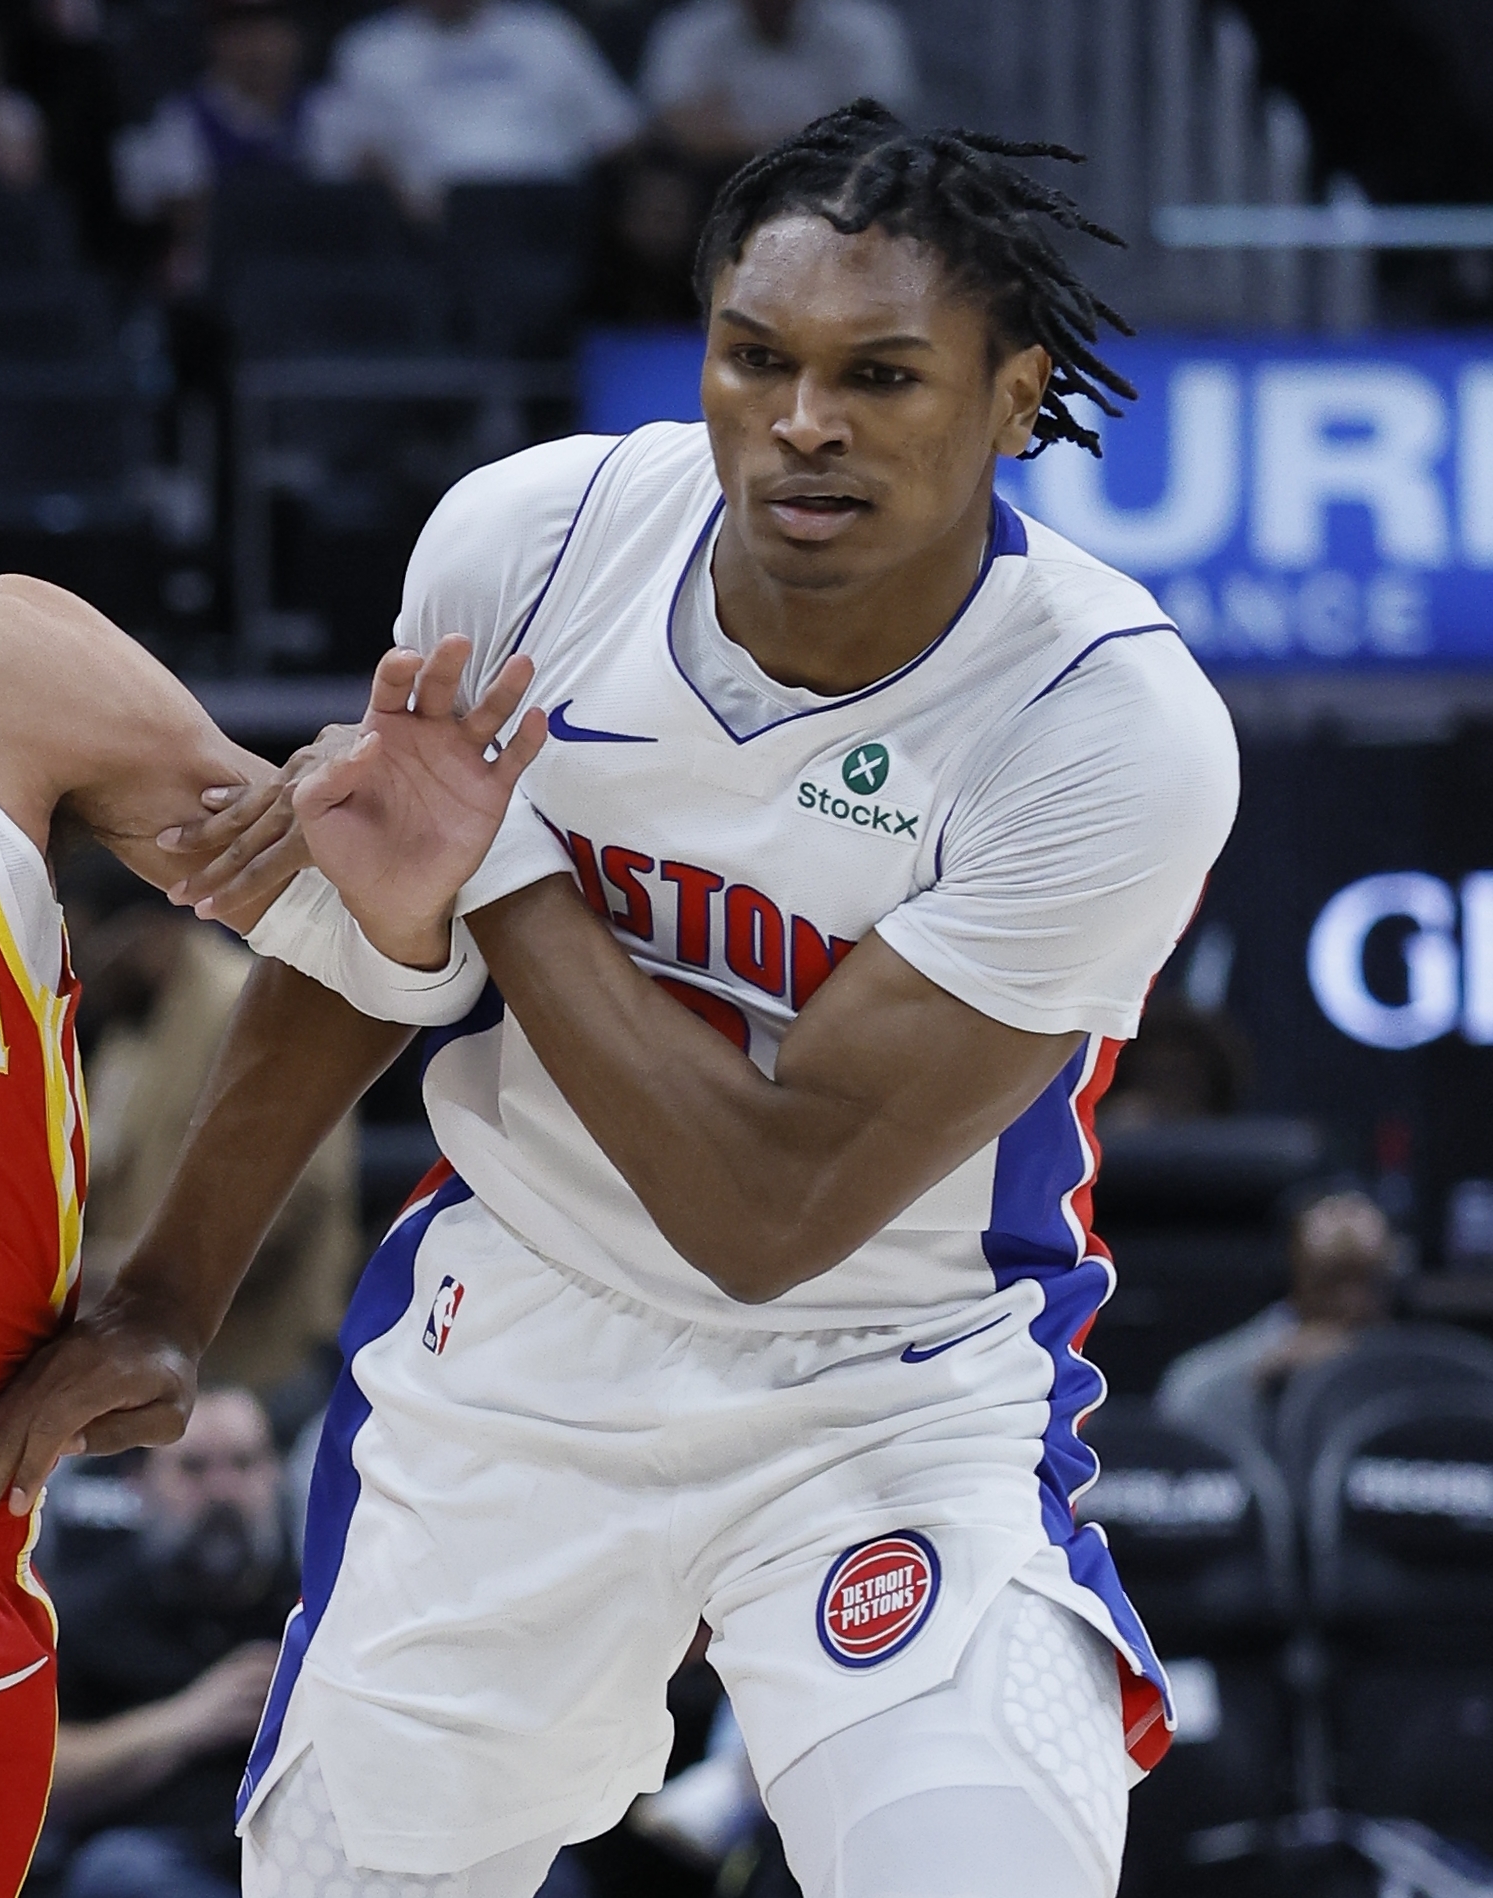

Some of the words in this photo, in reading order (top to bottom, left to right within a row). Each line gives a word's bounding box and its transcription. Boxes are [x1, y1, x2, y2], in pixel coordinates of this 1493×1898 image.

[797, 782, 920, 840] StockX
[840, 1586, 915, 1631] PISTONS
[841, 1565, 915, 1608] DETROIT
